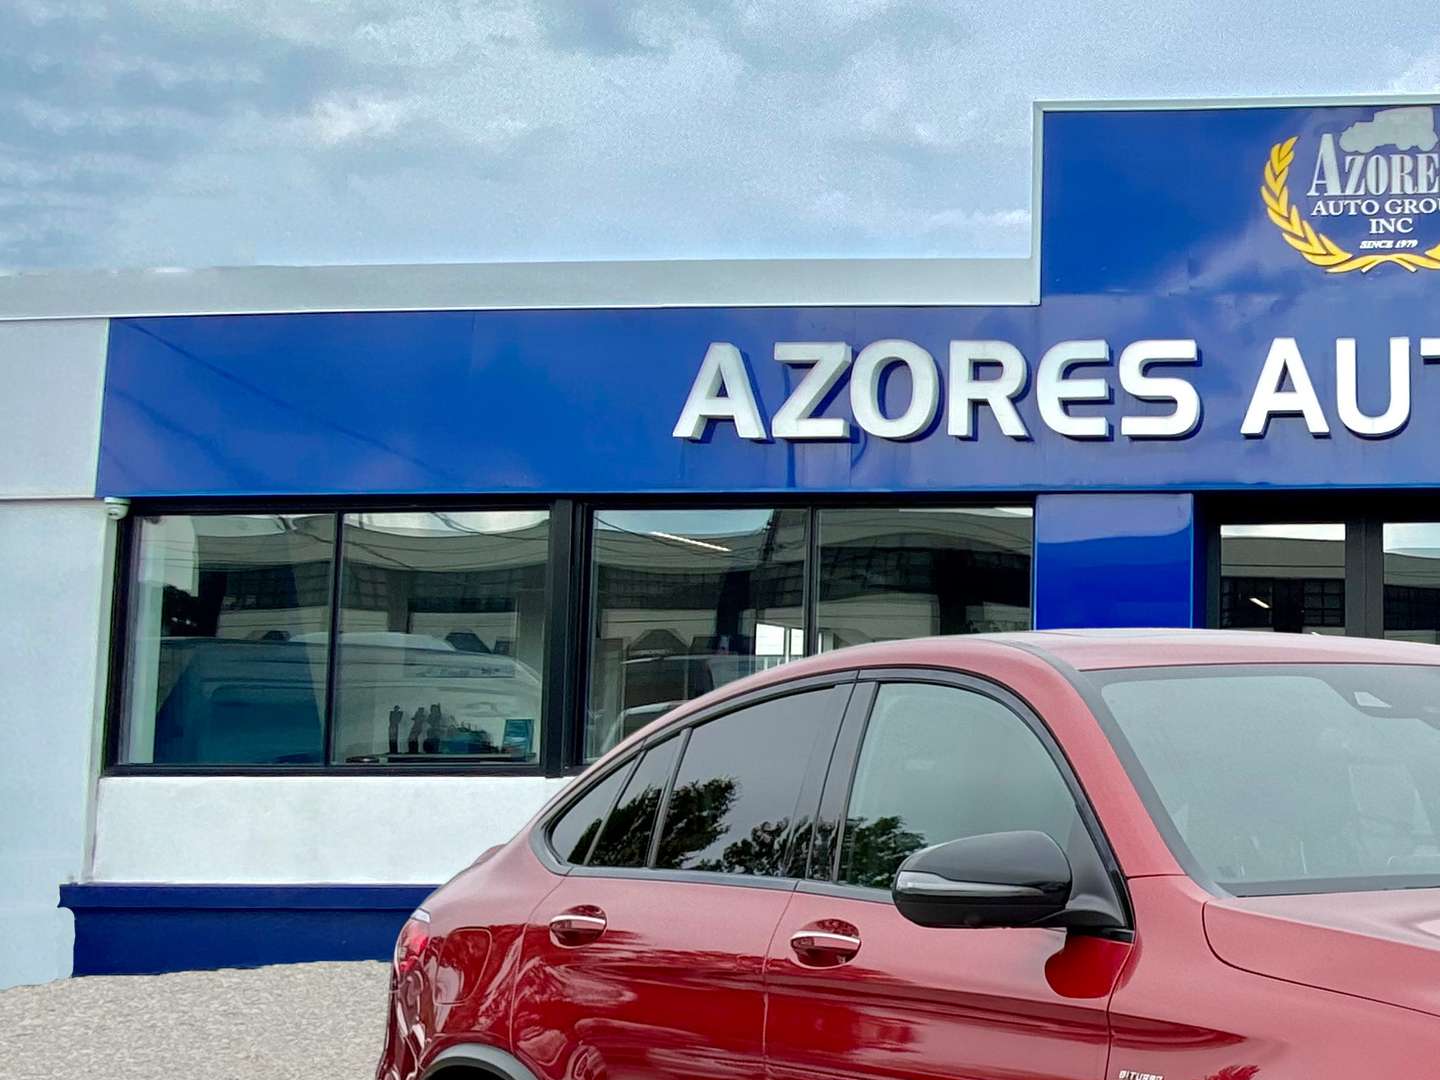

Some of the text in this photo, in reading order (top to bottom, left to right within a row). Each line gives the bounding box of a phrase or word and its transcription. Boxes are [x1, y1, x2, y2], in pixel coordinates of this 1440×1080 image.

[1311, 199, 1381, 216] AUTO
[1369, 217, 1414, 234] INC
[1359, 239, 1418, 249] SINCE 1979
[673, 338, 1204, 440] AZORES
